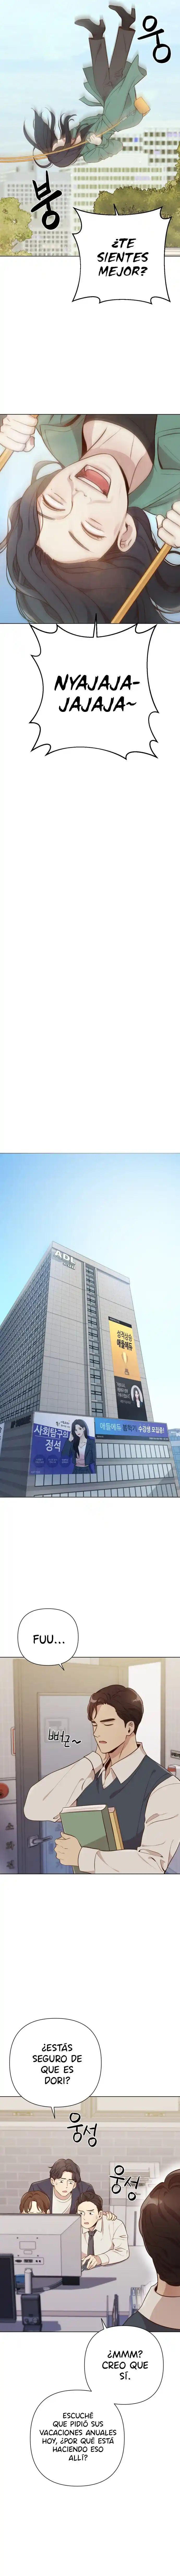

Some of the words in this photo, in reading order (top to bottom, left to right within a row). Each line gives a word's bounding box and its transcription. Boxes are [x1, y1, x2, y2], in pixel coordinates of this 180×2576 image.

[137, 15, 171, 63] 웅
[31, 170, 62, 230] 붕
[112, 238, 136, 248] ¿TE
[97, 251, 149, 263] SIENTES
[99, 266, 148, 277] MEJOR?
[54, 674, 140, 691] NYAJAJA-
[59, 696, 137, 712] JAJAJA~
[53, 1250, 75, 1265] ADL
[117, 1330, 132, 1342] 성적상승
[117, 1339, 133, 1351] 애들에듀
[34, 1425, 68, 1439] 사회탐구의
[100, 1423, 122, 1431] 애들에듀
[122, 1424, 137, 1432] 봄학기
[138, 1424, 151, 1433] 수강생
[45, 1439, 61, 1452] 정석
[33, 1635, 65, 1644] FUU...
[42, 2043, 73, 2052] ¿ESTÁS
[41, 2066, 59, 2074] QUE
[45, 2076, 70, 2084] DORI?
[67, 2112, 97, 2147] 웅성
[109, 2165, 140, 2201] 웅성
[107, 2350, 143, 2358] ¿MMM?
[102, 2361, 126, 2369] CREO
[130, 2361, 148, 2370] QUE
[119, 2371, 130, 2380] SÍ.
